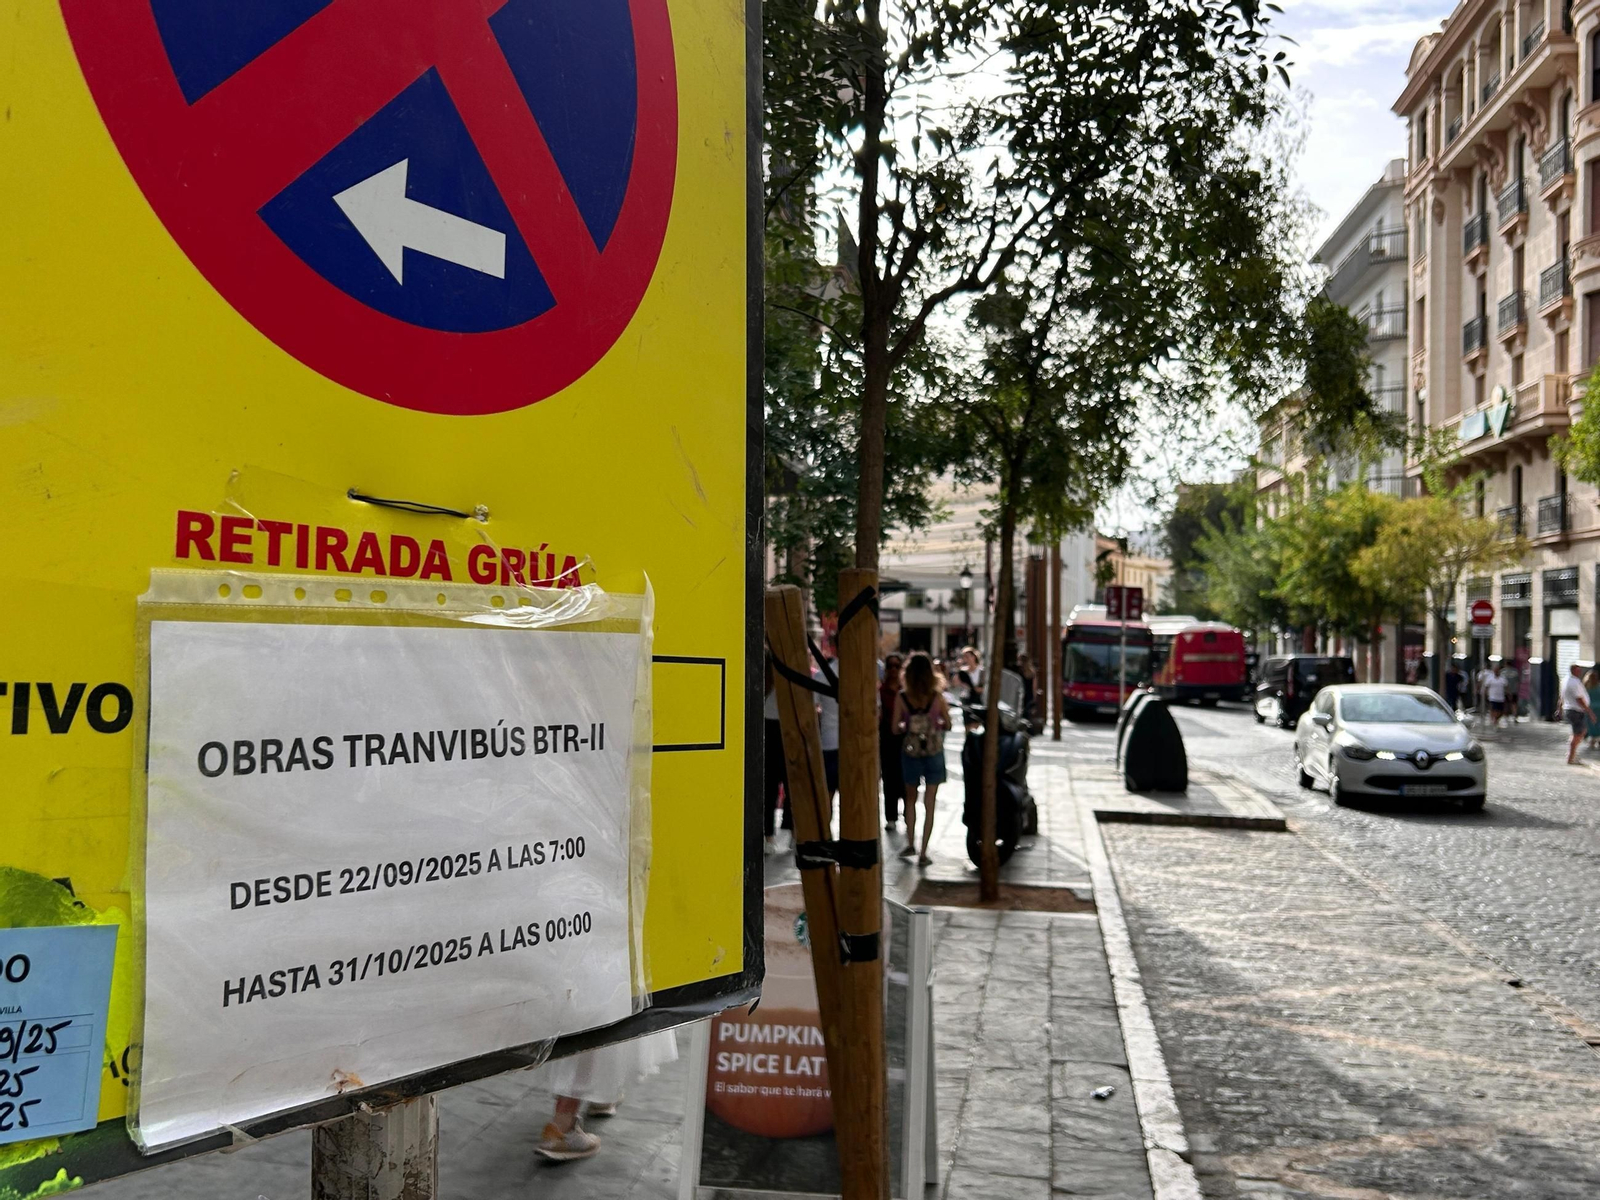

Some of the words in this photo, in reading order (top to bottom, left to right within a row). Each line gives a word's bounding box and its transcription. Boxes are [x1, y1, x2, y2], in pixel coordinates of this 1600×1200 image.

[175, 511, 452, 581] RETIRADA
[468, 543, 581, 589] GRÚA
[0, 682, 133, 735] IVO
[198, 735, 334, 777] OBRAS
[343, 719, 525, 768] TRANVIBÚS
[533, 723, 605, 754] BTR-II
[230, 870, 332, 910] DESDE
[339, 851, 482, 894] 22/09/2025
[487, 849, 502, 873] A
[507, 841, 545, 869] LAS
[549, 836, 585, 862] 7:00
[0, 953, 31, 983] O
[223, 964, 321, 1007] HASTA
[328, 936, 472, 985] 31/10/2025
[477, 932, 493, 957] A
[500, 922, 540, 953] LAS
[545, 911, 592, 943] 00:00
[719, 1022, 825, 1046] PUMPKIN
[716, 1051, 780, 1073] SPICE
[784, 1055, 827, 1076] LAT
[727, 1082, 758, 1094] sabor
[760, 1086, 781, 1097] que
[783, 1085, 796, 1096] te
[796, 1085, 822, 1097] hará
